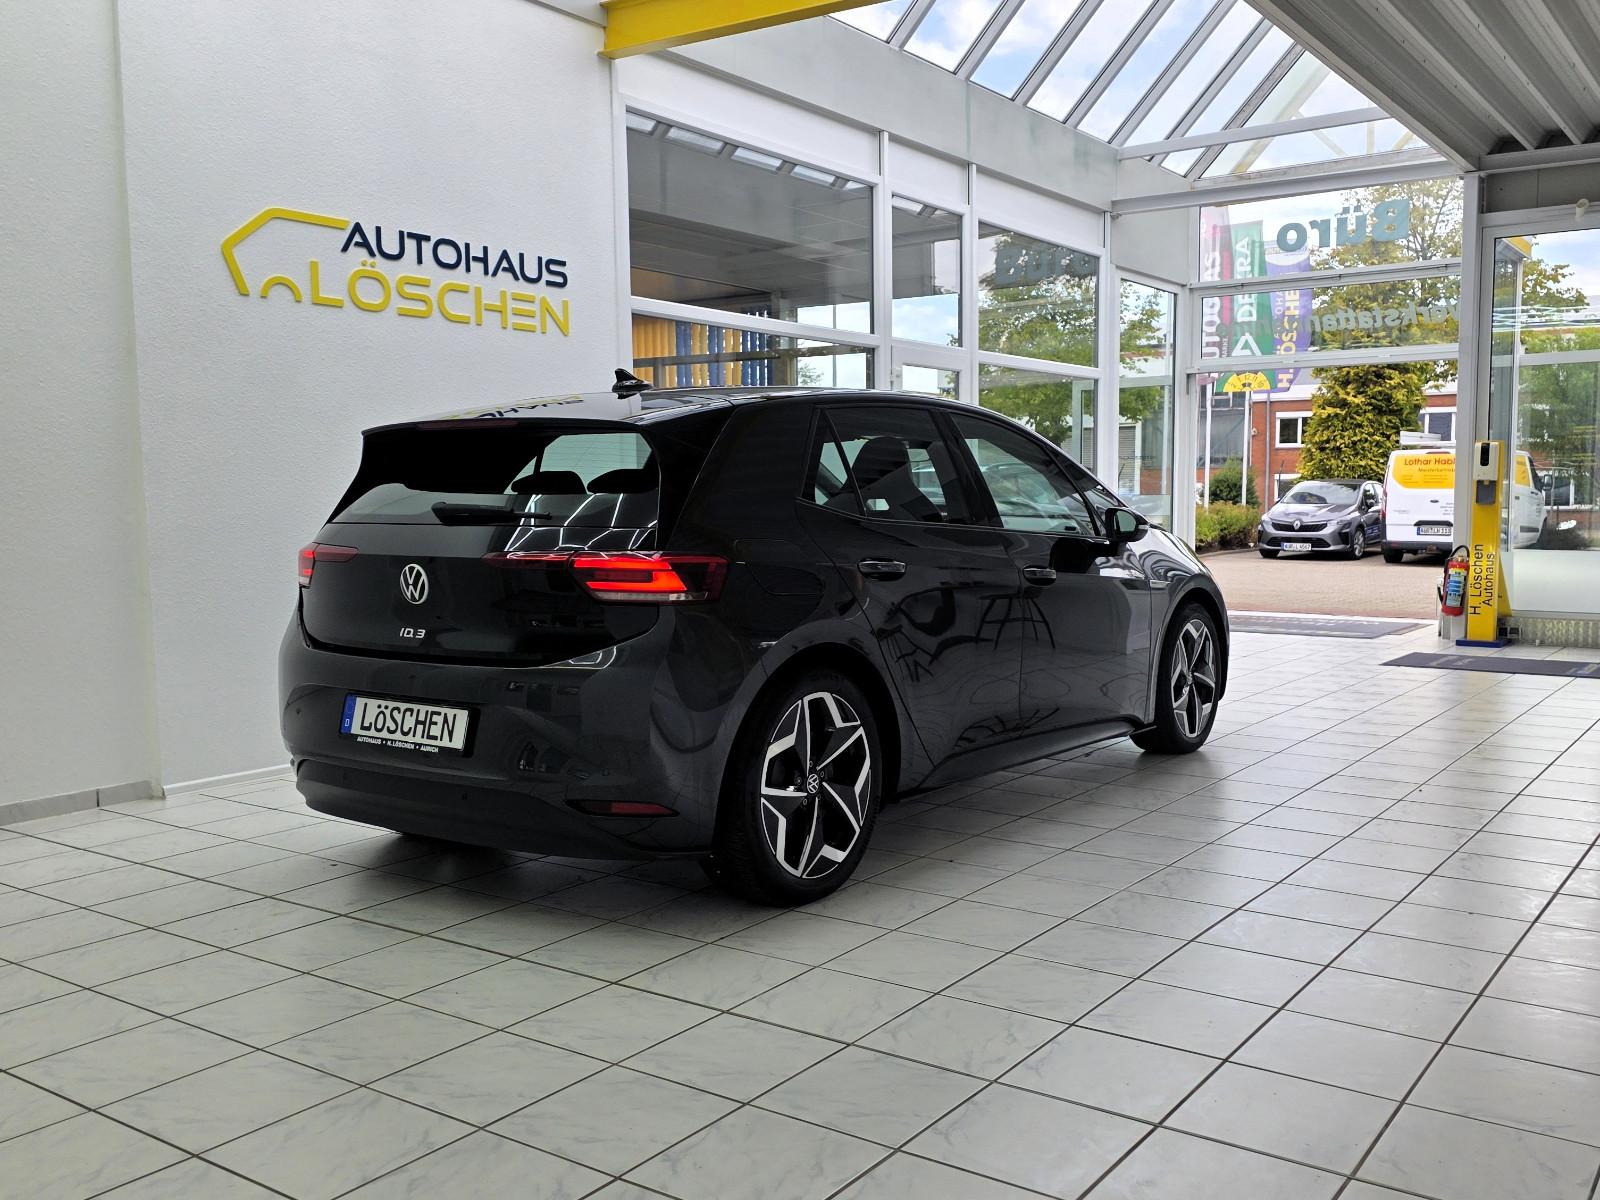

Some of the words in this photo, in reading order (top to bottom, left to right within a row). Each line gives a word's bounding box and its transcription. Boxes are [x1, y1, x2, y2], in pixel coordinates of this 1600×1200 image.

[340, 221, 569, 288] AUTOHAUS
[309, 258, 570, 337] LÖSCHEN
[1404, 458, 1431, 466] Lothar
[1470, 544, 1484, 597] Löschen
[1482, 553, 1495, 607] Autohaus
[1469, 602, 1481, 615] H.
[357, 736, 382, 745] AUTOHAUS
[420, 745, 439, 753] AURICH
[360, 702, 457, 743] LÖSCHEN
